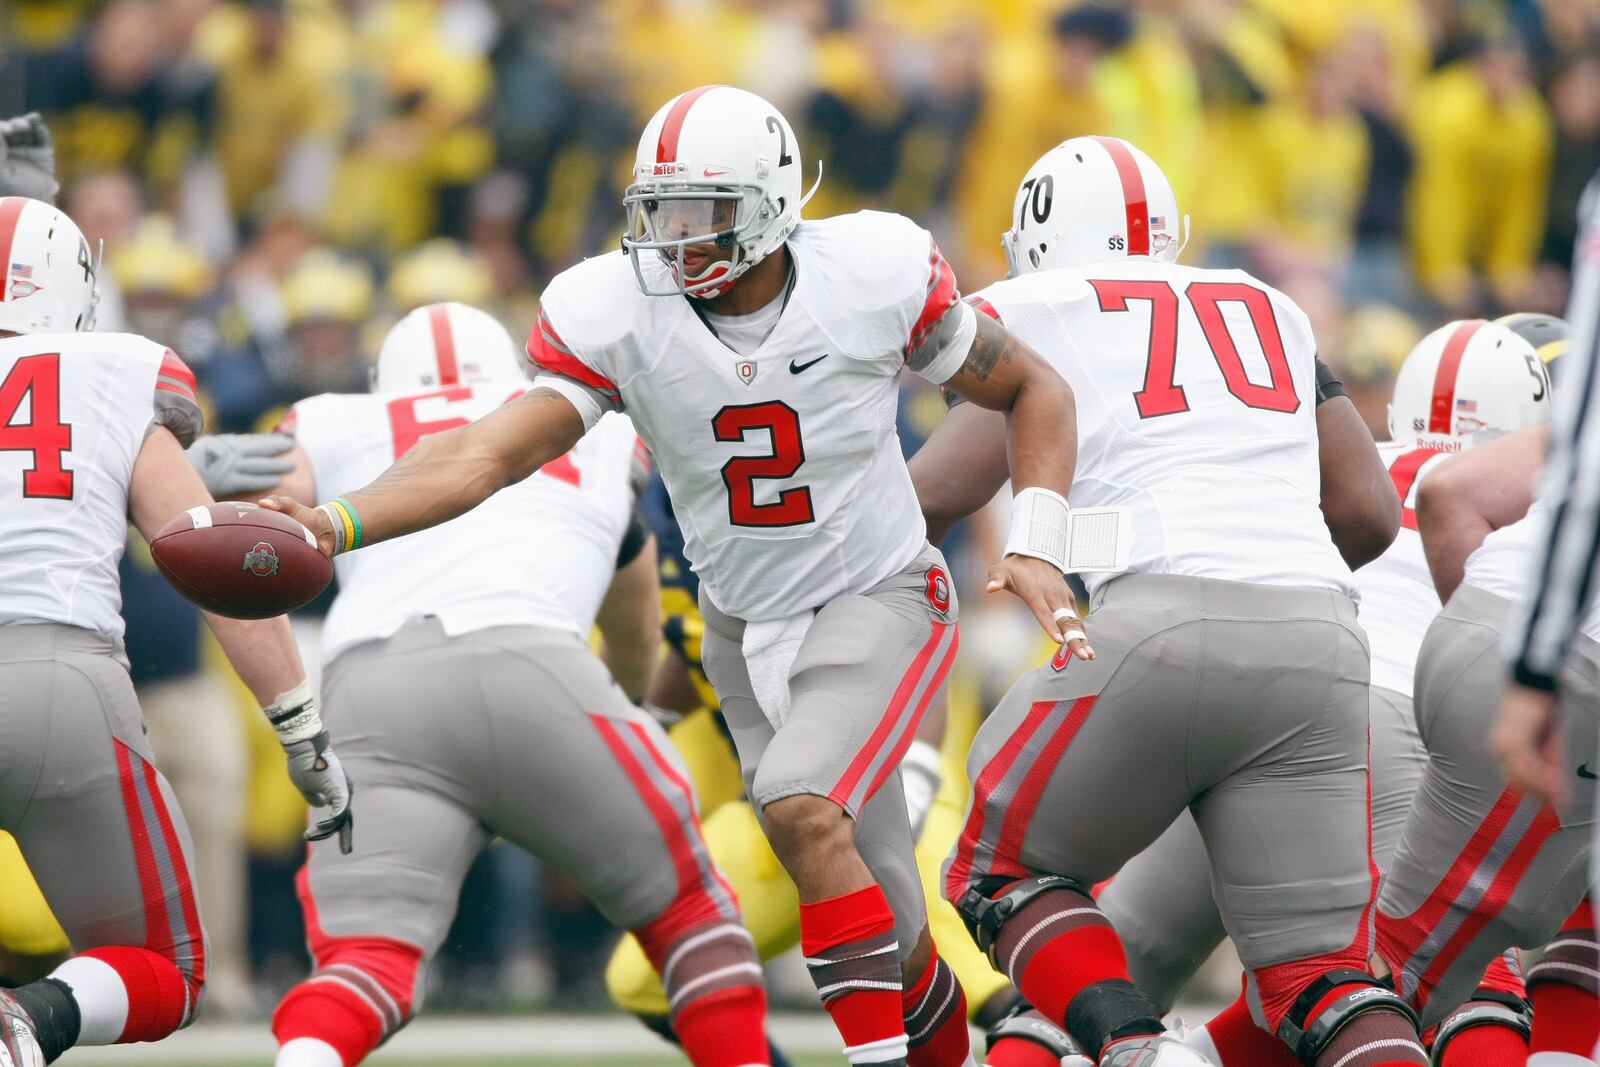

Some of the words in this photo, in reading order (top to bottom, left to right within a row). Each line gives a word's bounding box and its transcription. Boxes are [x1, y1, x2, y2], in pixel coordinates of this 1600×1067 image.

[766, 116, 792, 168] 2
[1021, 174, 1054, 231] 70
[1108, 237, 1124, 251] SS
[1086, 279, 1301, 419] 70
[1524, 355, 1551, 402] 5
[0, 352, 73, 501] 4
[1416, 438, 1462, 452] Riddell
[711, 399, 816, 527] 2
